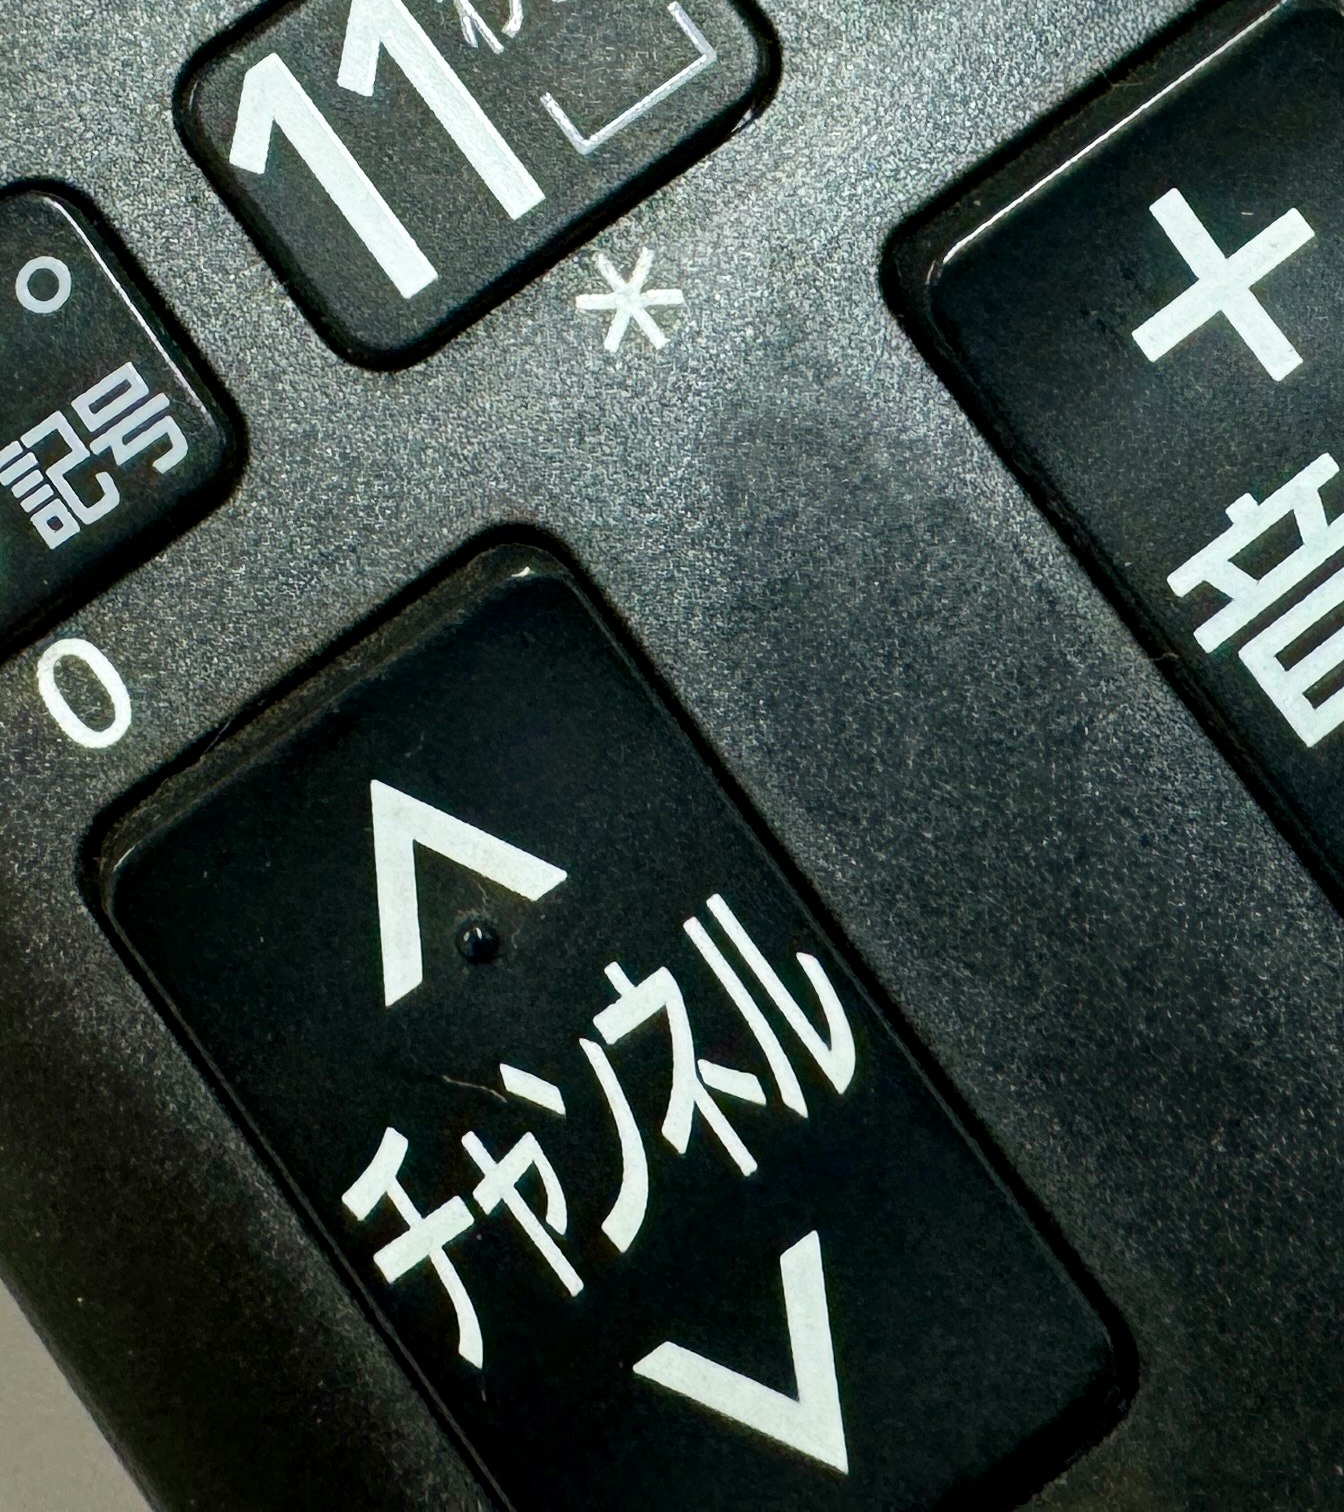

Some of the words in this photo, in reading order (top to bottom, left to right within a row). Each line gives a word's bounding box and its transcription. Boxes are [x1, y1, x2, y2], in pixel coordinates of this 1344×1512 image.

[340, 892, 856, 1370] チャンネル
